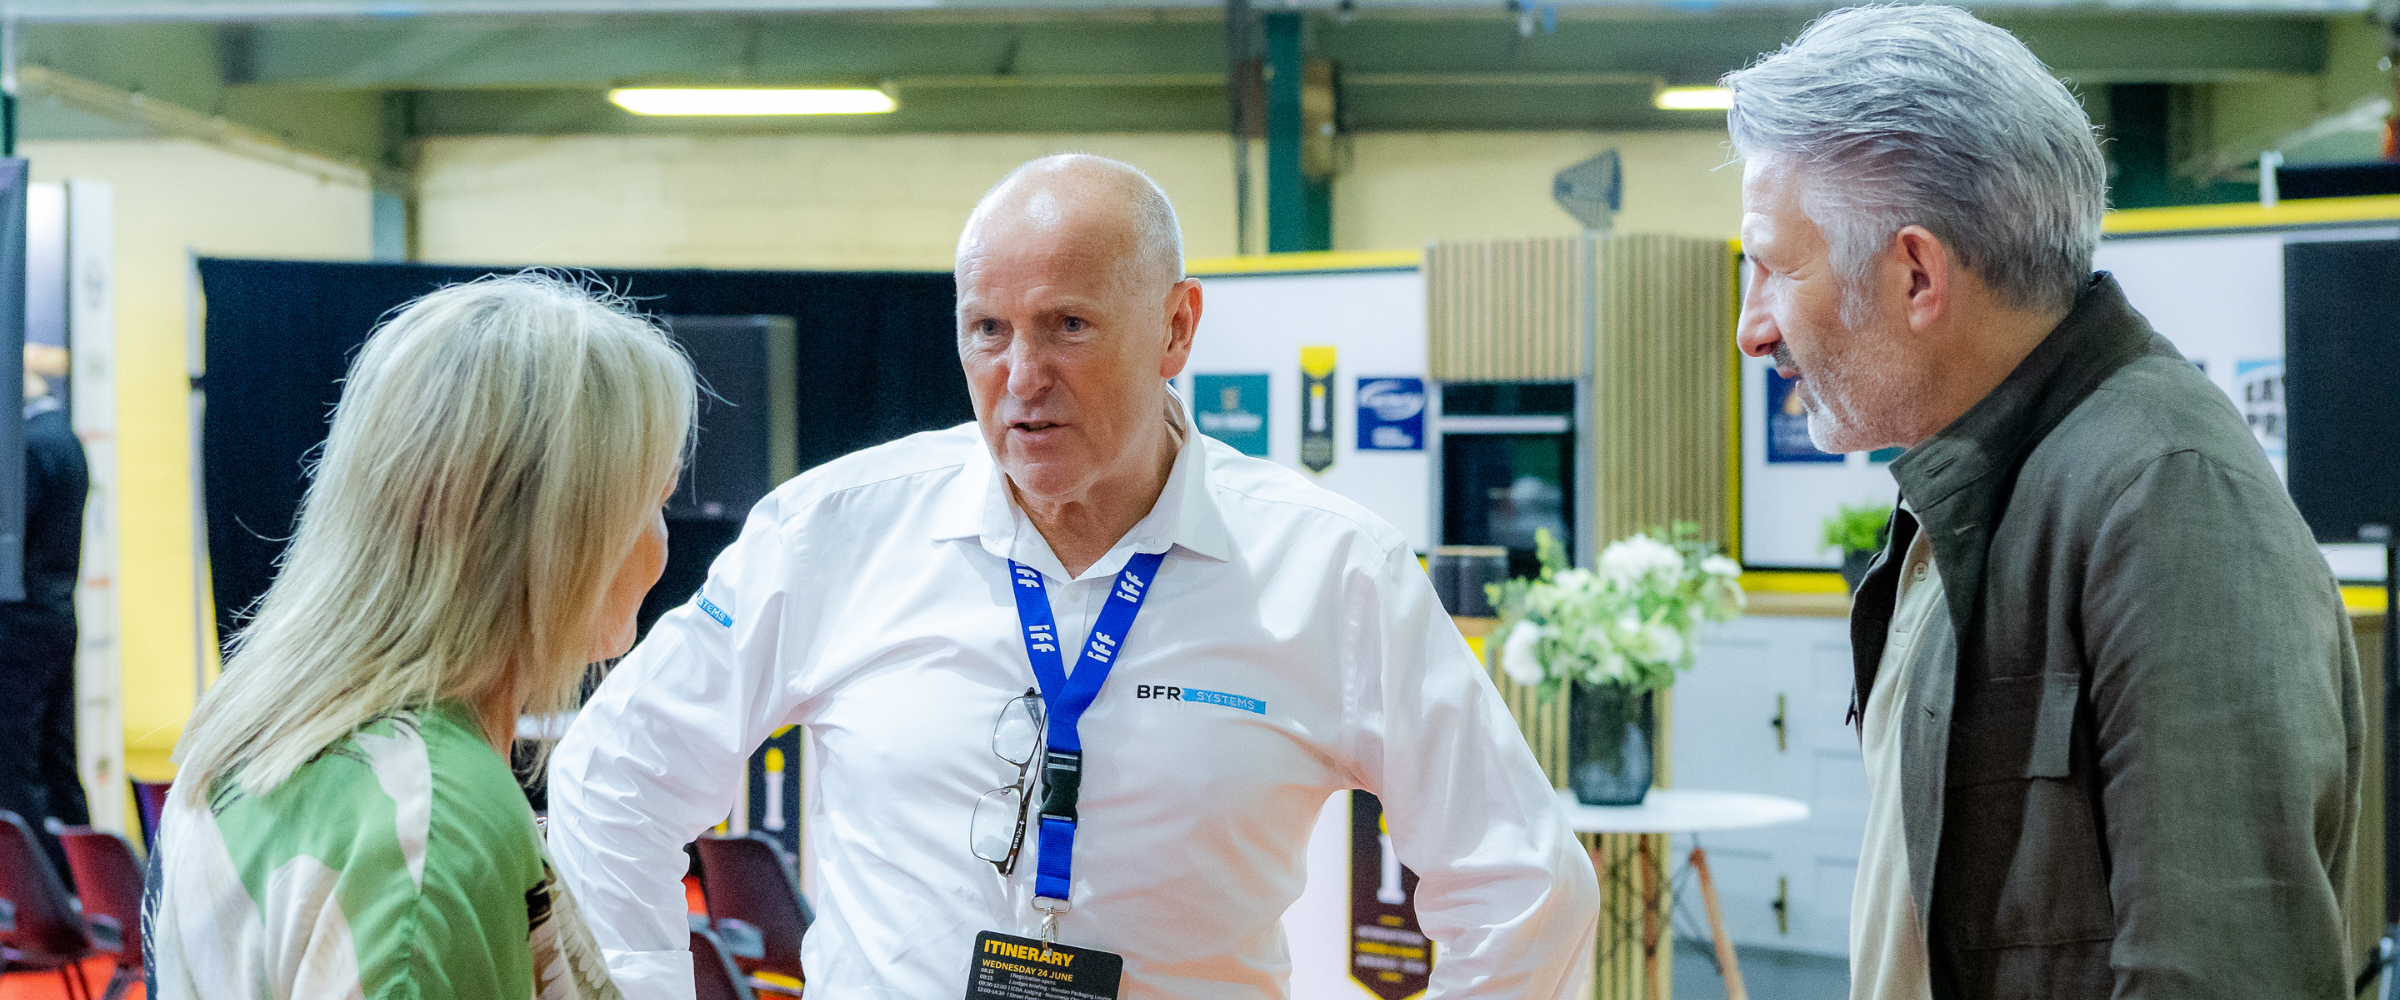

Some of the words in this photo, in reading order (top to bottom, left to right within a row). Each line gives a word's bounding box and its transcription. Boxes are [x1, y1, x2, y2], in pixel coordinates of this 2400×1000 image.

[697, 597, 726, 621] STEMS
[1136, 684, 1181, 701] BFR
[1196, 691, 1255, 710] SYSTEMS
[984, 939, 1075, 967] ITINERARY
[982, 958, 1037, 975] WEDNESDAY
[1037, 968, 1048, 977] 24
[1049, 971, 1074, 982] JUNE
